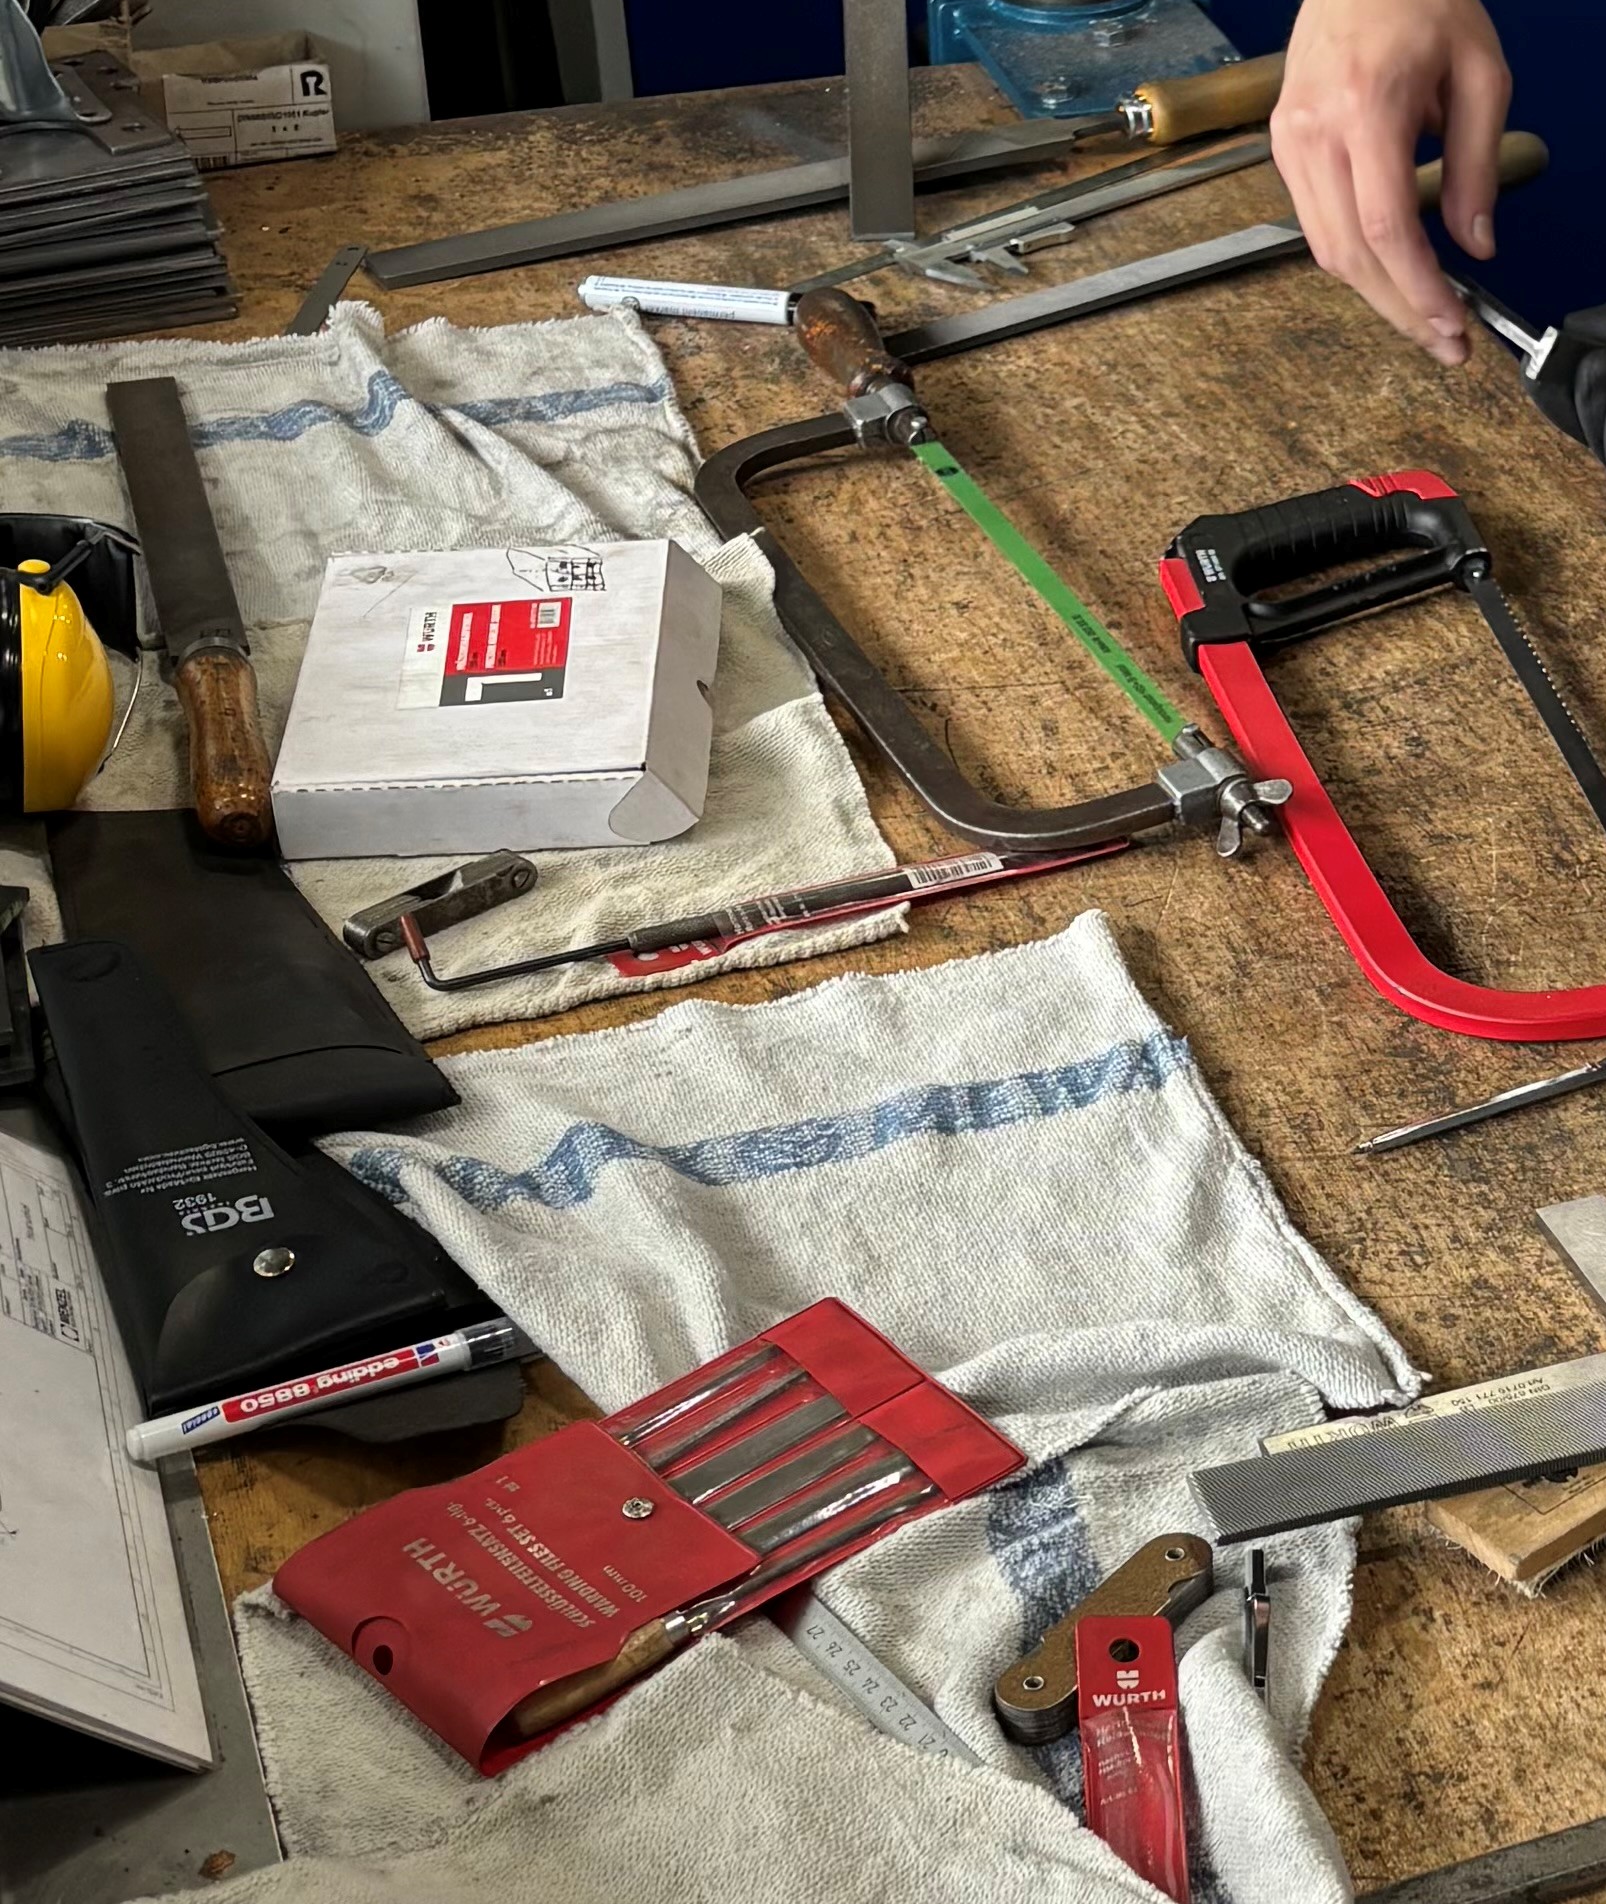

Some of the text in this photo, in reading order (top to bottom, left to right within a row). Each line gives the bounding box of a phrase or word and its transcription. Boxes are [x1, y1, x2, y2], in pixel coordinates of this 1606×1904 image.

[172, 1193, 216, 1210] 1932
[239, 1355, 401, 1414] edding 8850
[506, 1521, 537, 1546] SET
[526, 1540, 565, 1572] FILES
[401, 1533, 501, 1618] WÜRTH
[467, 1523, 597, 1630] SCHLÜSSELFEILENSATZ
[556, 1567, 620, 1619] WARDING
[807, 1622, 936, 1750] 21 22 23 24 25 26 27
